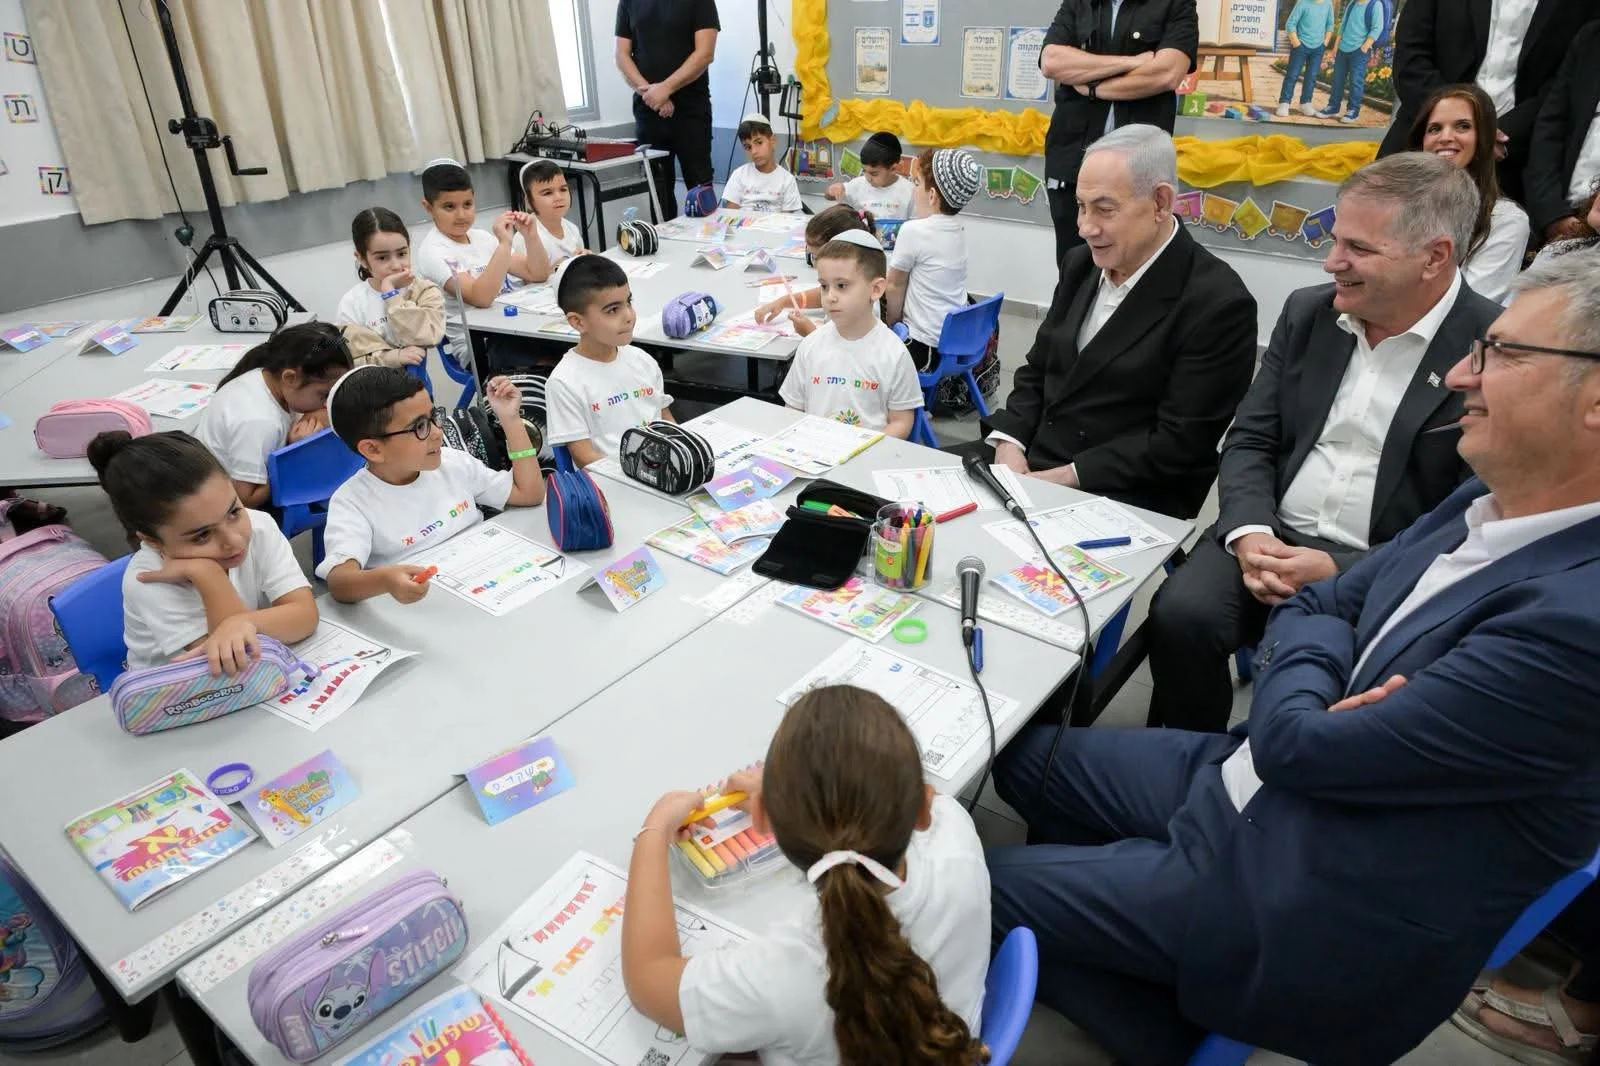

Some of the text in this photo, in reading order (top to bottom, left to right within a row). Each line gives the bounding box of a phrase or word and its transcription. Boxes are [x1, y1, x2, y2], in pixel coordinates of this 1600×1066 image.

[1230, 3, 1265, 13] ומקשיבים,
[1233, 15, 1261, 23] חושבים,
[12, 38, 29, 56] ט
[11, 99, 30, 116] ת
[1189, 99, 1199, 113] ג
[47, 172, 62, 194] ק
[827, 376, 846, 385] כיתה
[855, 378, 879, 390] שלום
[608, 392, 629, 406] כיתה
[633, 387, 654, 398] שלום
[449, 500, 469, 518] שלום
[420, 520, 444, 537] כיתה
[388, 919, 460, 987] STITCH
[422, 1014, 482, 1059] שלום
